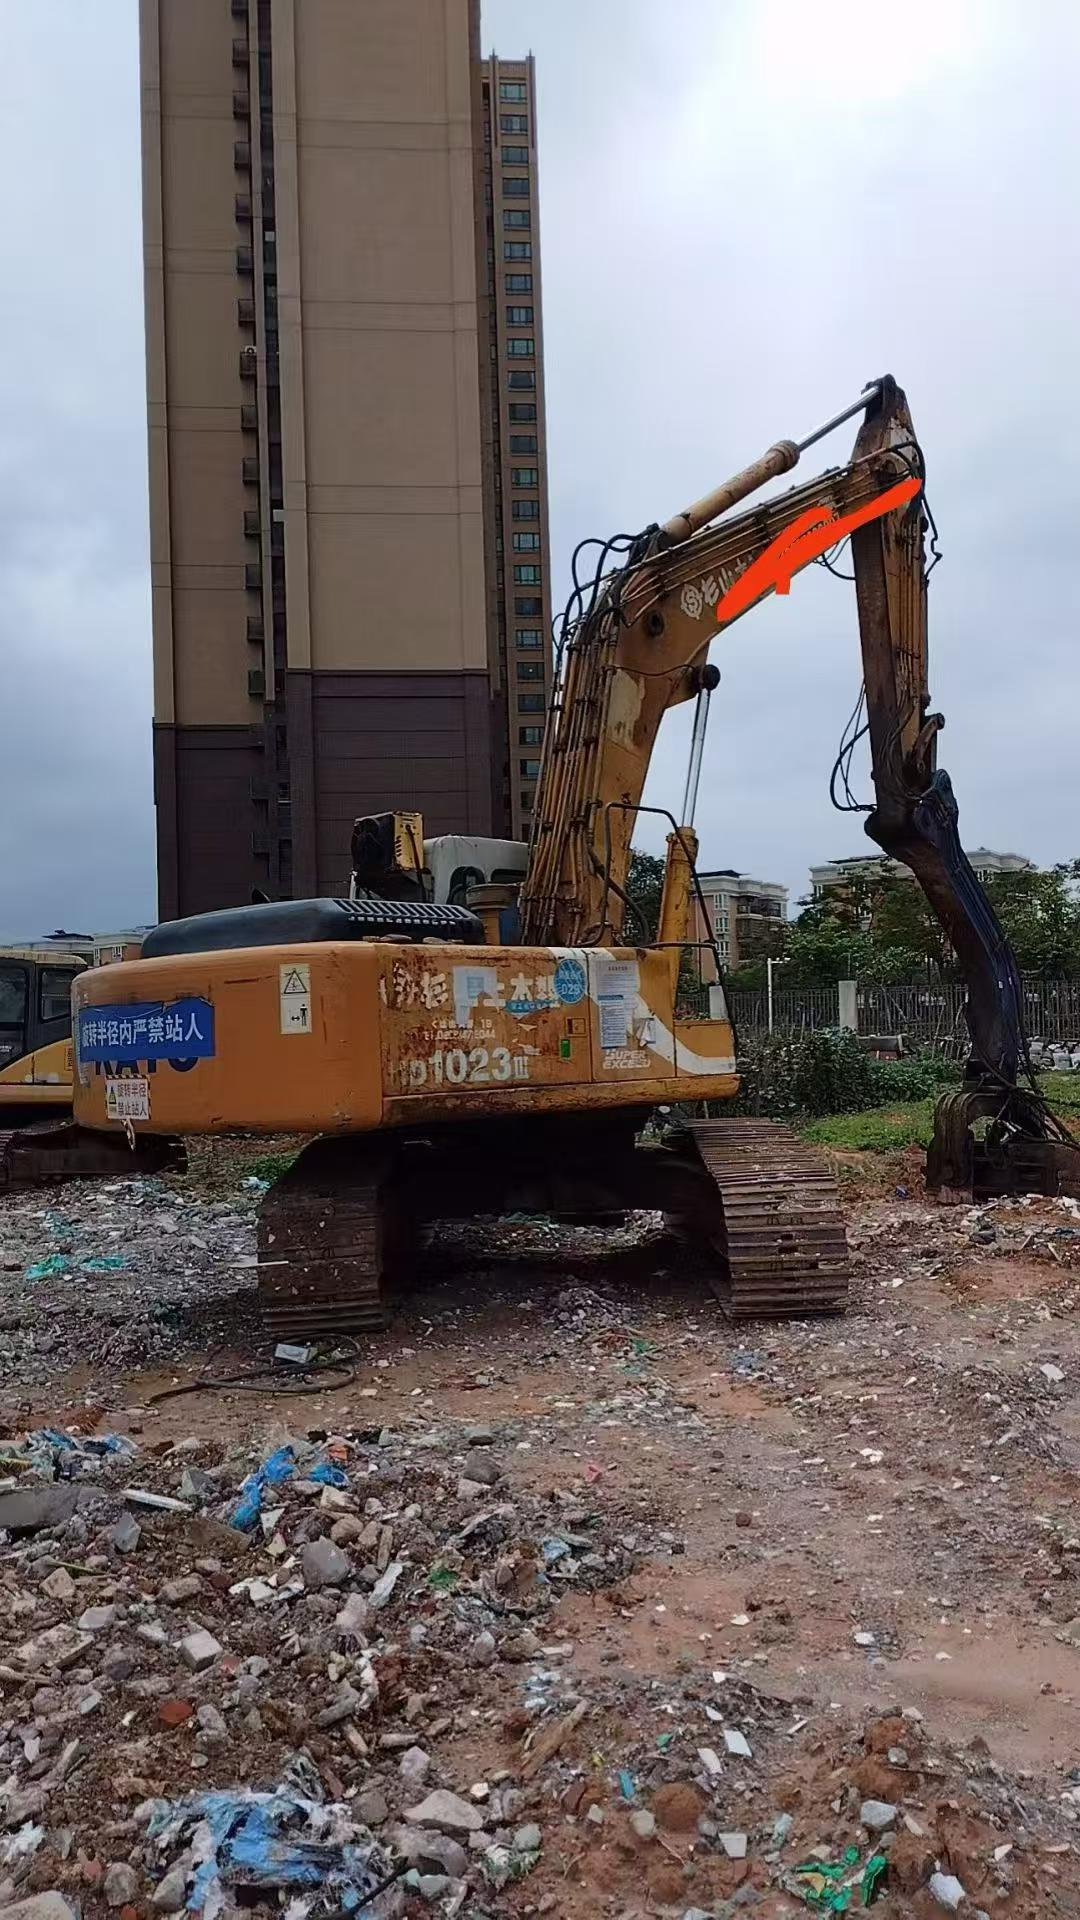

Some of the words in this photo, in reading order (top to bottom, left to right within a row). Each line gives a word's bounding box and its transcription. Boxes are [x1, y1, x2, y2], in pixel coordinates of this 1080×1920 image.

[82, 1013, 204, 1048] 旋转半径内严禁站人
[117, 1101, 147, 1116] 禁止站人
